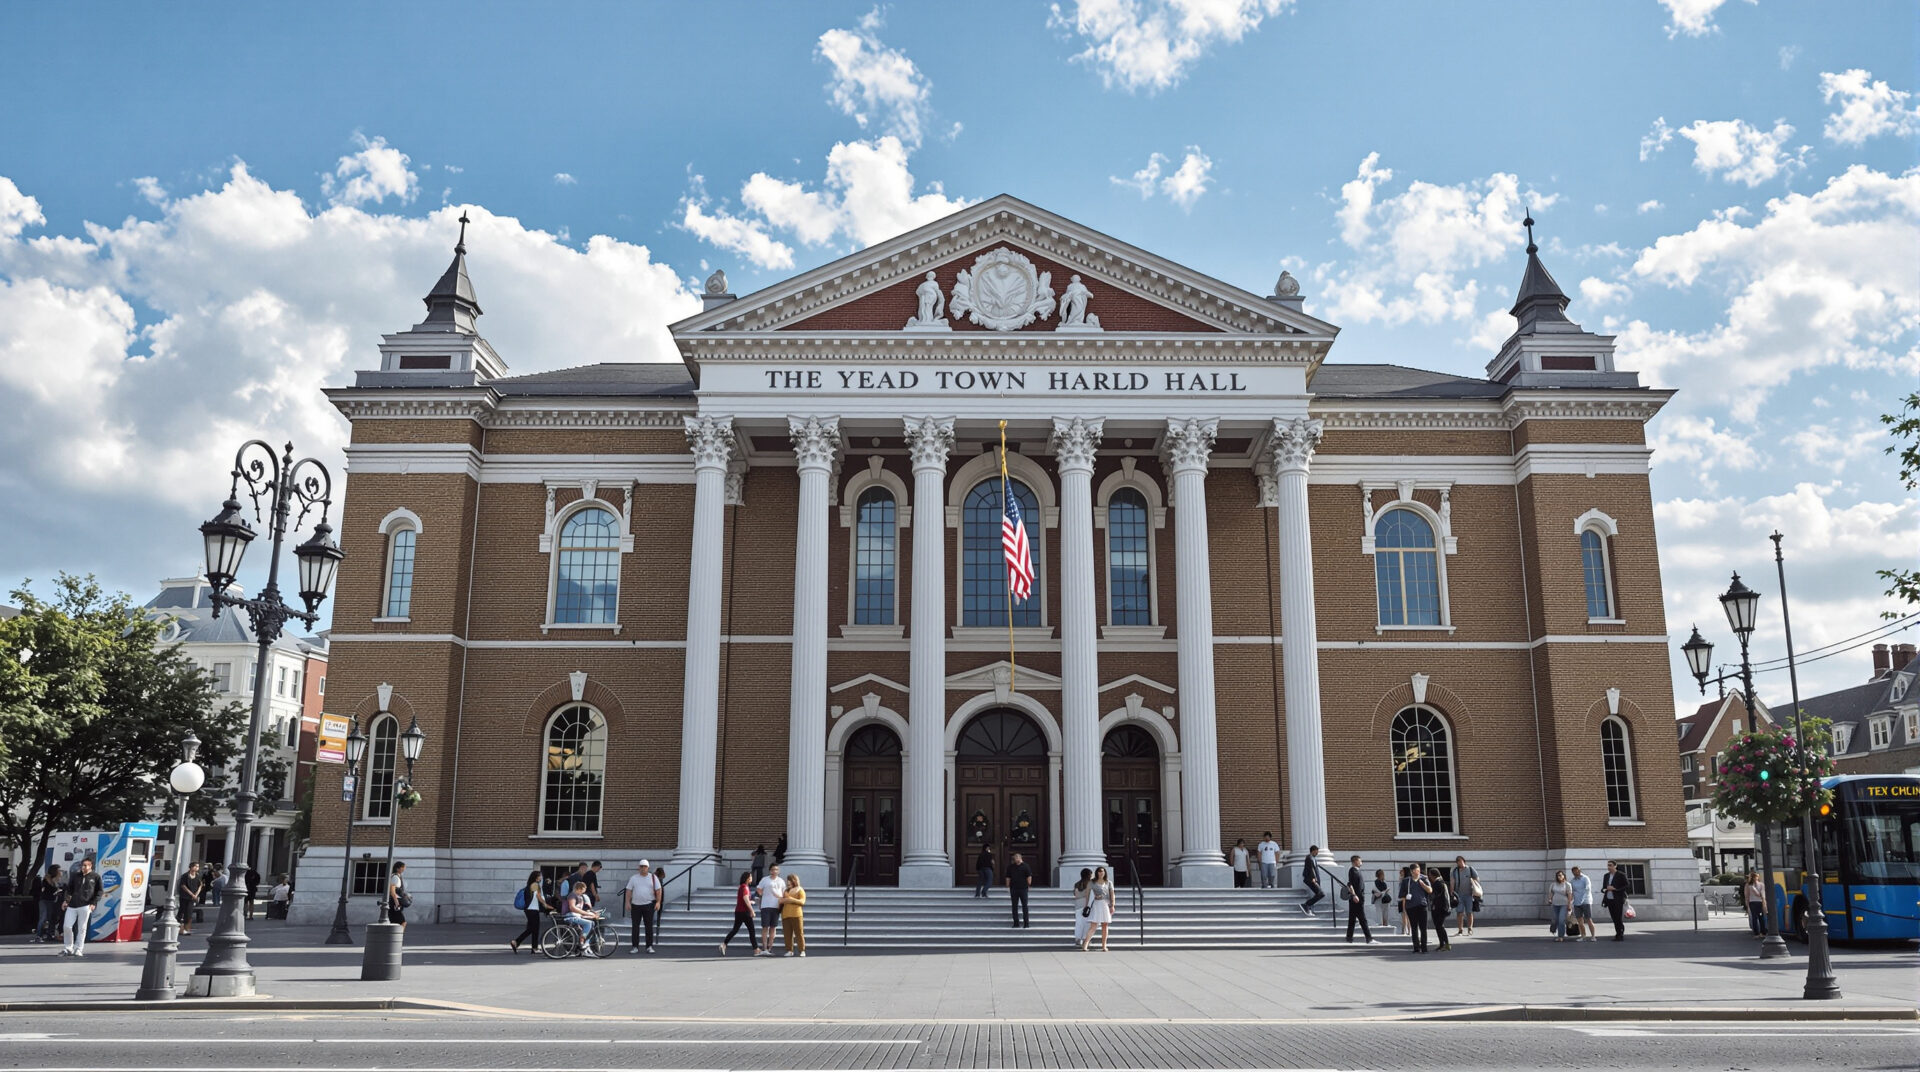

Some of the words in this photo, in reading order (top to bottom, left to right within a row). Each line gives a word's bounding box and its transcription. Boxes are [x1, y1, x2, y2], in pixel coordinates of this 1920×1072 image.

[764, 370, 822, 389] THE
[837, 370, 919, 389] YEAD
[935, 371, 1026, 390] TOWN
[1048, 372, 1149, 391] HARLD
[1164, 372, 1247, 391] HALL
[1867, 786, 1888, 796] TEX
